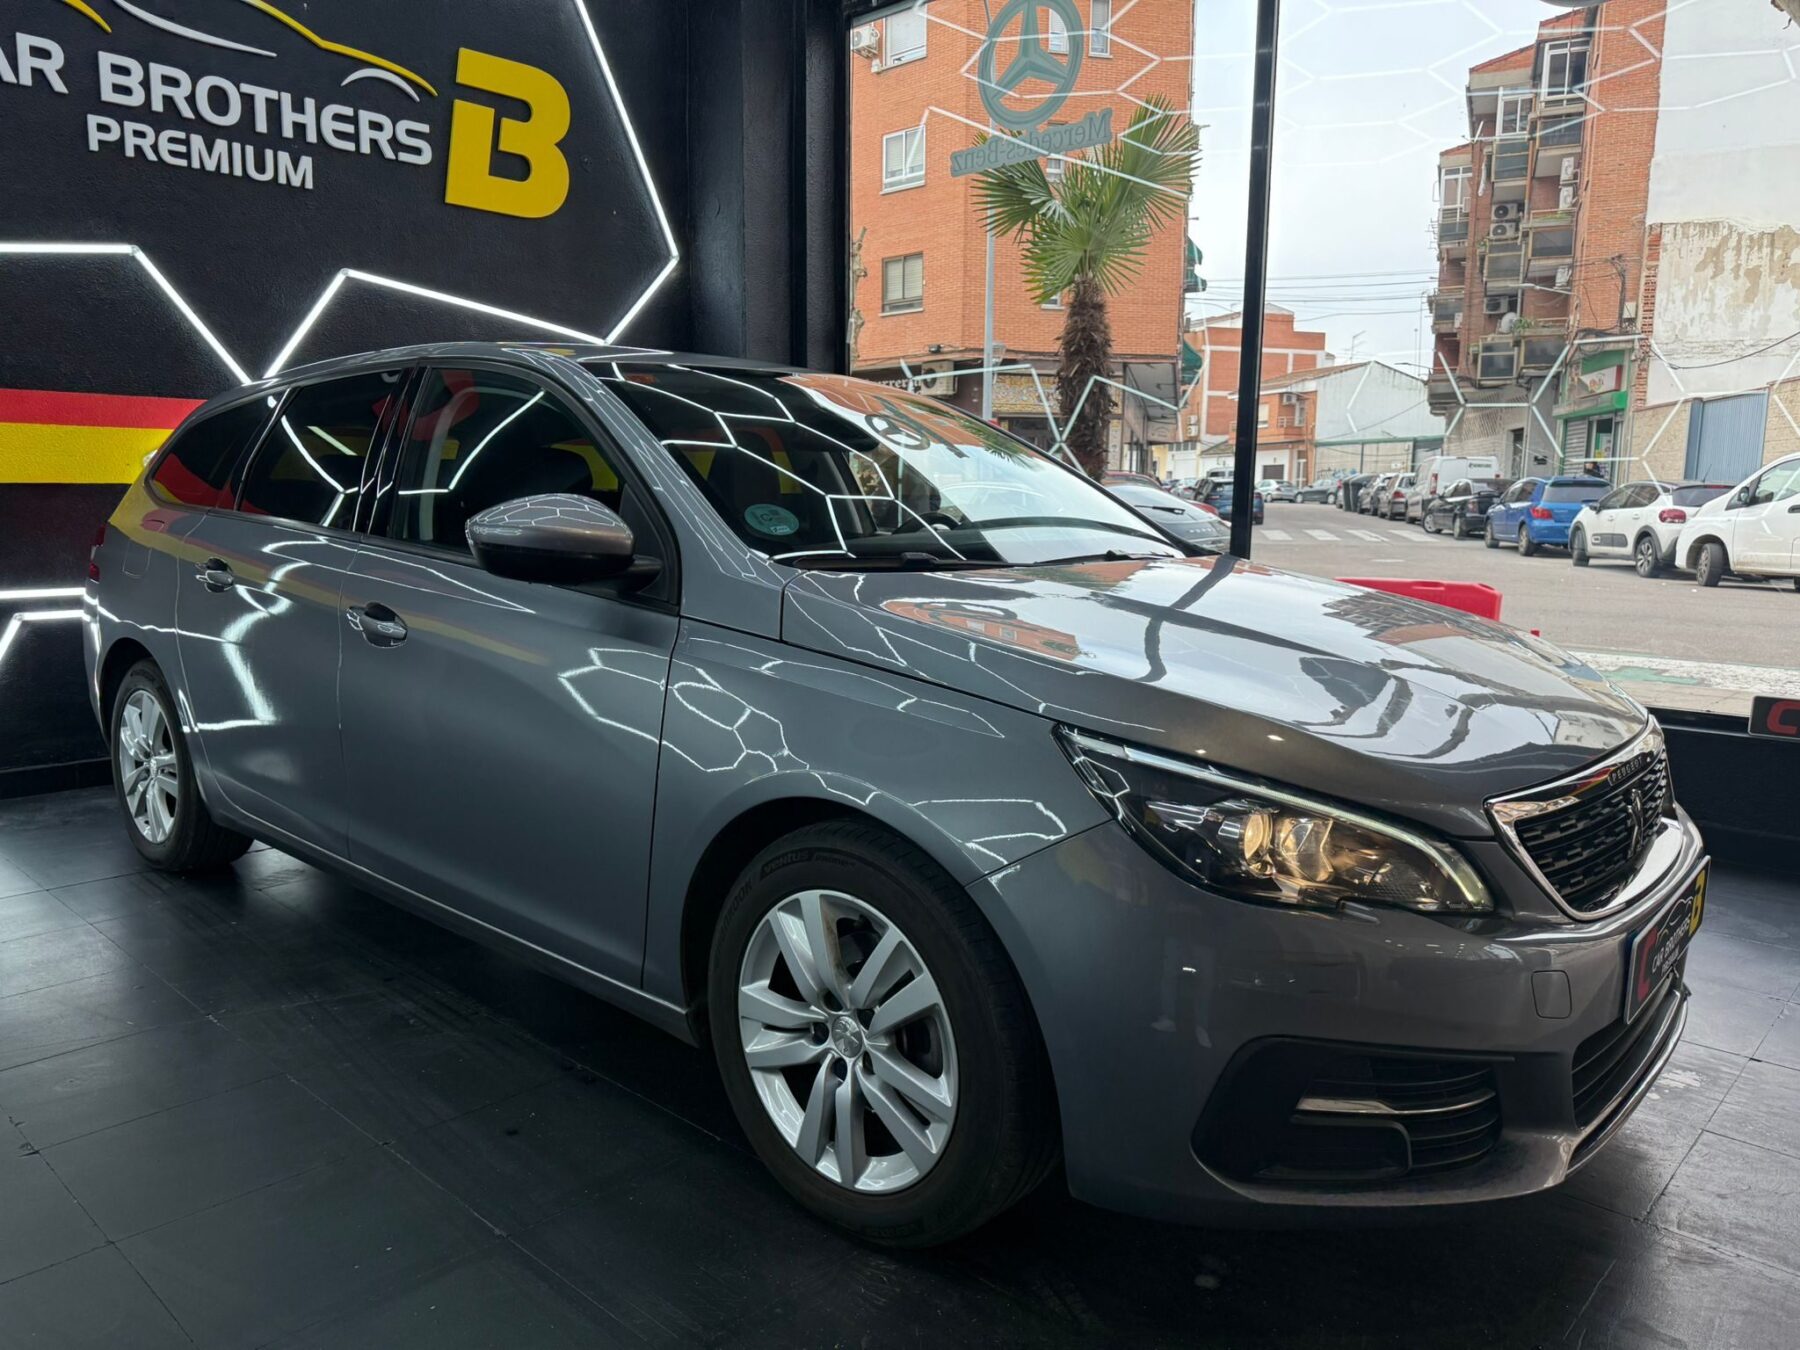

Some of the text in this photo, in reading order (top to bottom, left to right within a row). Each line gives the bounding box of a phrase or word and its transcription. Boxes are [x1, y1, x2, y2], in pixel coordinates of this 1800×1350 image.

[87, 113, 314, 189] PREMIUM
[98, 50, 432, 166] BROTHERS
[445, 47, 571, 218] B
[1664, 913, 1691, 958] BROTHERS
